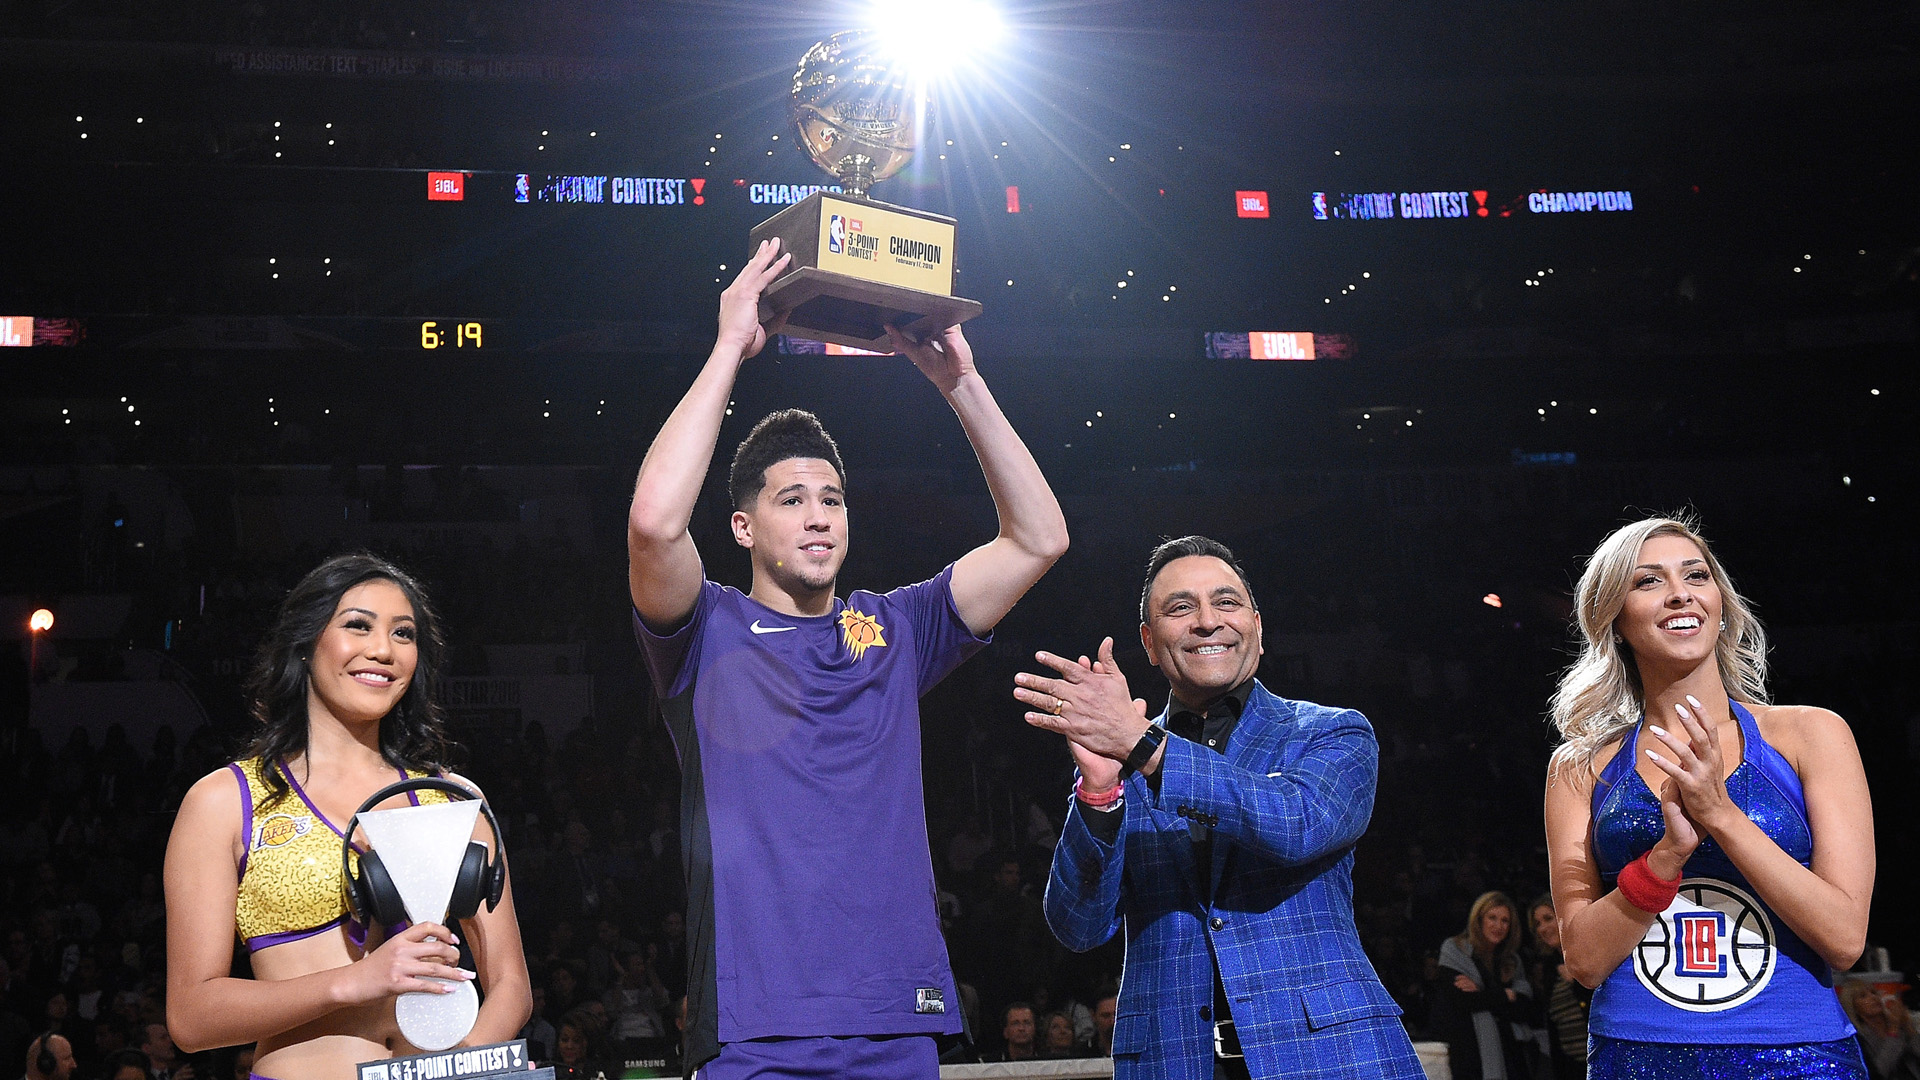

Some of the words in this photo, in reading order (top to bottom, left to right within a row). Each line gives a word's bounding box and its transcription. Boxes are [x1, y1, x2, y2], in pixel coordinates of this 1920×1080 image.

[249, 53, 325, 72] ASSISTANCE?
[330, 56, 357, 73] TEXT
[435, 180, 459, 194] JBL
[1242, 198, 1264, 211] JBL
[1528, 191, 1634, 214] CHAMPION
[848, 232, 879, 251] 3-POINT
[889, 236, 941, 264] CHAMPION
[895, 257, 916, 267] February
[1262, 334, 1305, 359] JBL
[255, 821, 309, 849] LAKERS
[402, 1052, 454, 1080] 3-POINT
[624, 1059, 666, 1068] SAMSUNG
